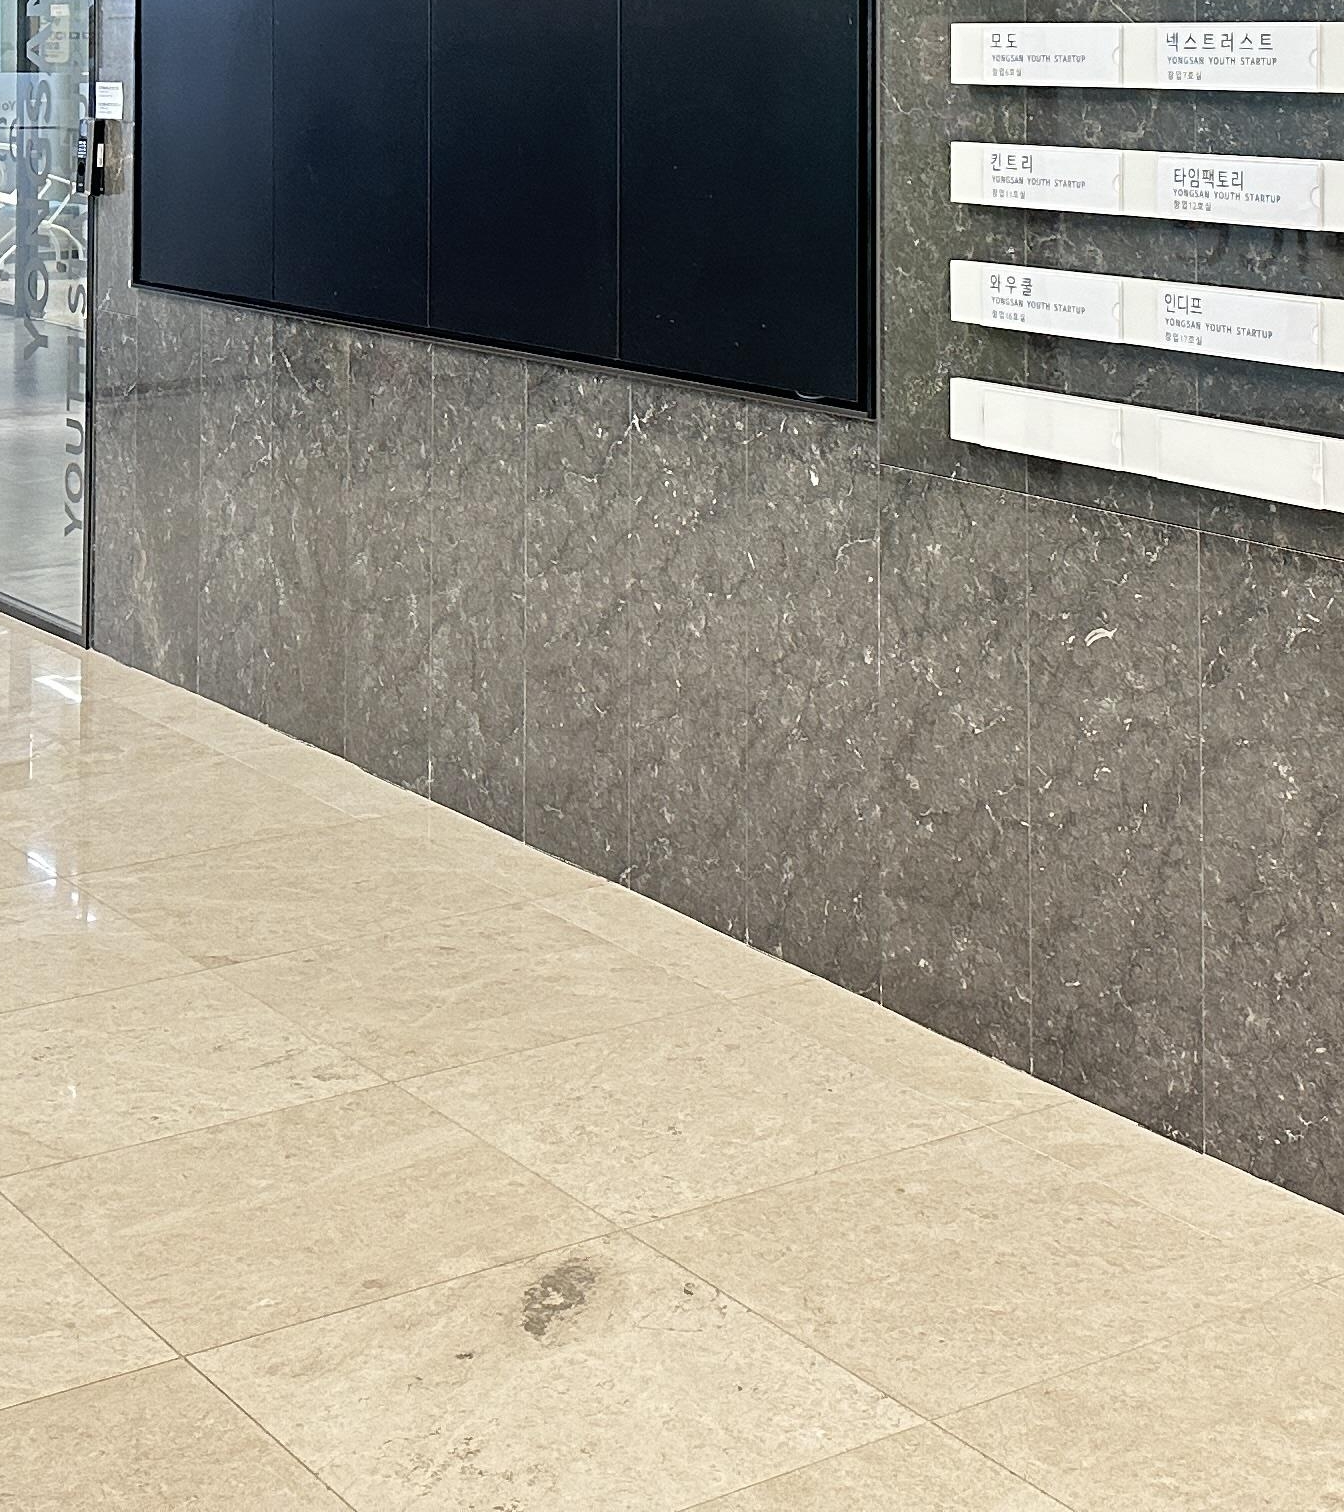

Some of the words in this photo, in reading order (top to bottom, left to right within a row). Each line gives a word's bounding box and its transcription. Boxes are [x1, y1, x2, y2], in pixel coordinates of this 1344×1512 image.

[990, 33, 1018, 49] 모도
[1166, 31, 1274, 53] 넥스트러스트
[1167, 56, 1205, 65] YONGSAN
[1207, 56, 1236, 66] YOUTH
[1240, 56, 1278, 66] STARTUP
[1172, 167, 1245, 192] 타임팩토리
[1172, 188, 1210, 200] YONGSAN
[1213, 190, 1242, 202] YOUTH
[1244, 192, 1281, 204] STARTUP
[1164, 293, 1203, 315] 인디프
[1164, 317, 1202, 330] YONGSAN
[1204, 322, 1233, 335] YOUTH
[1236, 326, 1273, 340] STARTUP
